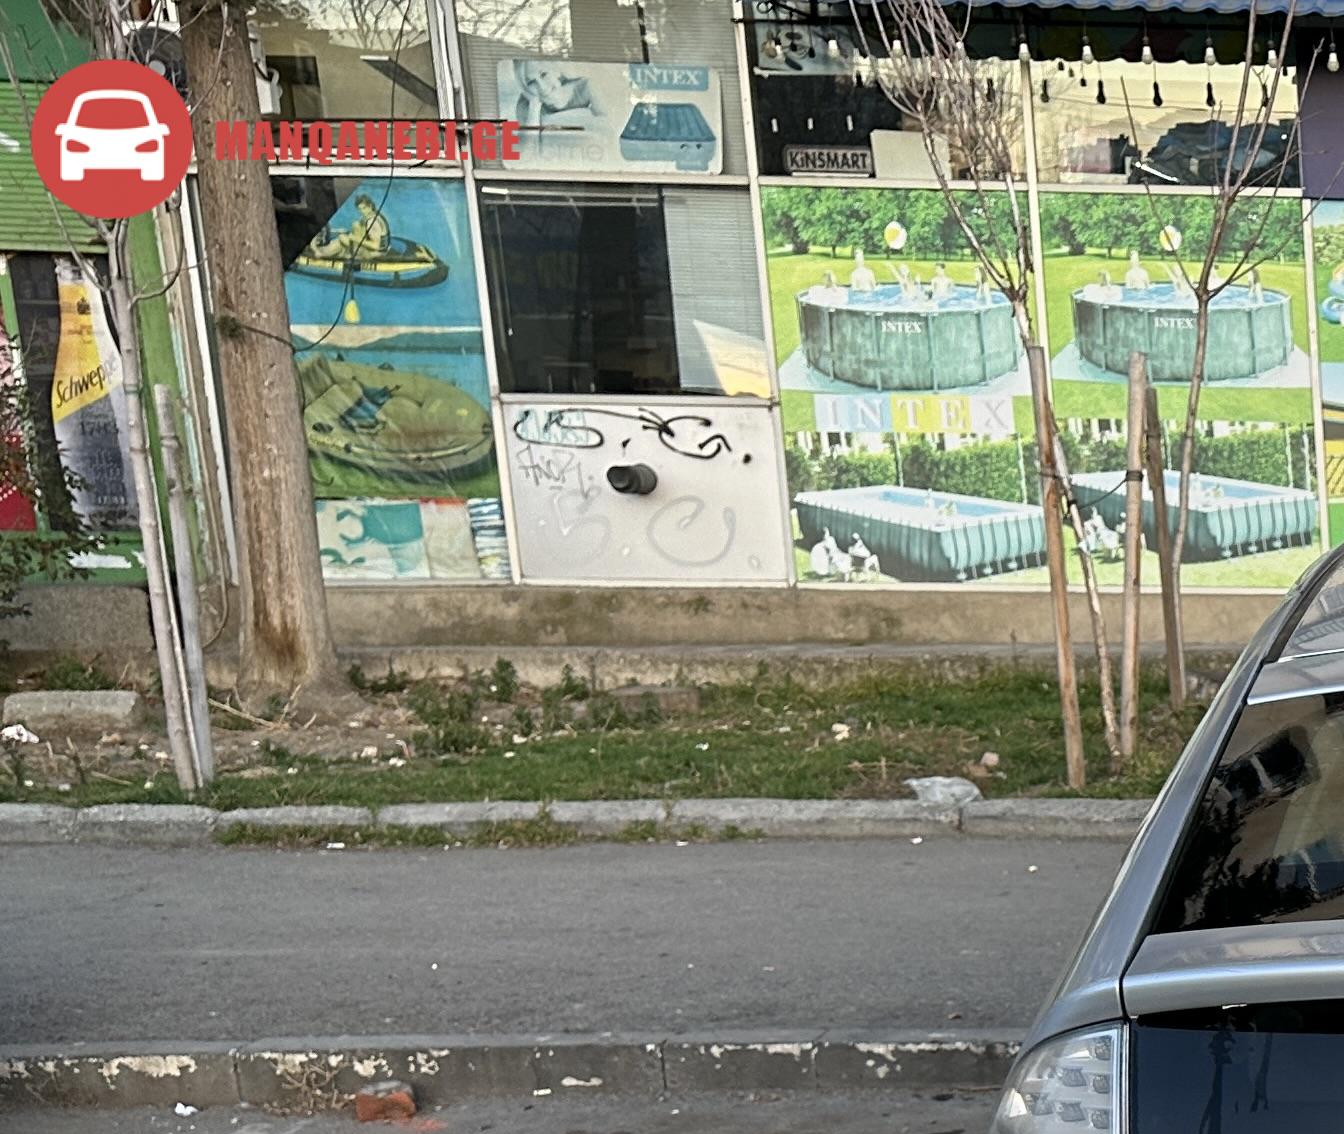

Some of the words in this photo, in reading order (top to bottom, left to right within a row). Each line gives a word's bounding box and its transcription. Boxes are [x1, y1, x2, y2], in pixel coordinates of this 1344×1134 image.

[636, 69, 699, 86] INTEX
[882, 321, 922, 334] INTEX
[1154, 316, 1195, 330] INTEX
[828, 398, 1009, 431] INTEX
